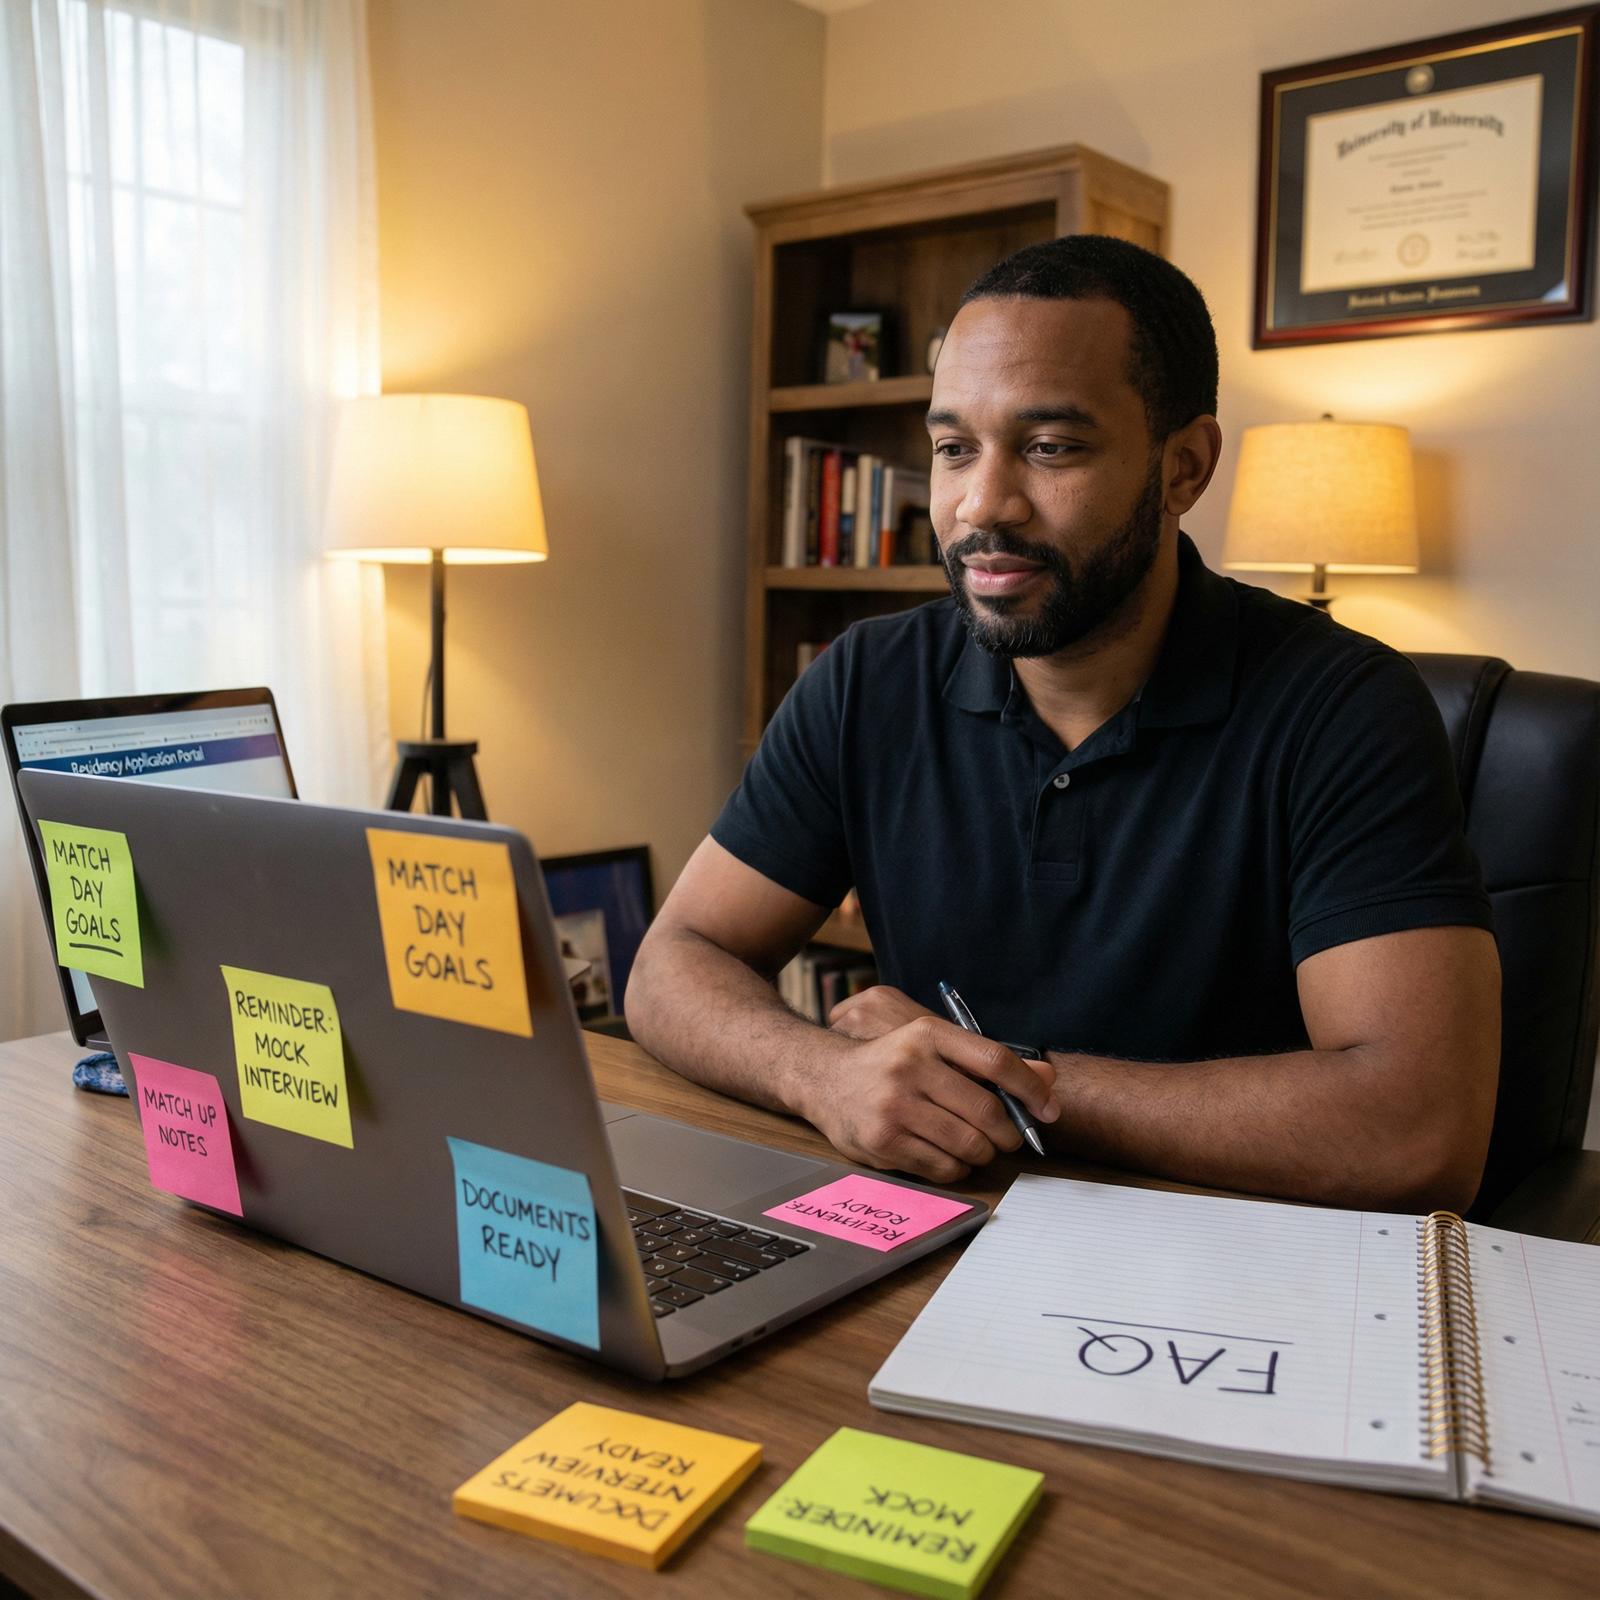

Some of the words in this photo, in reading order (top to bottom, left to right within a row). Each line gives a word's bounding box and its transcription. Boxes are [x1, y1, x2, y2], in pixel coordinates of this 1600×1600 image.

[52, 839, 112, 873] MATCH
[70, 875, 103, 909] DAY
[388, 858, 478, 900] MATCH
[66, 907, 121, 943] GOALS
[414, 904, 465, 948] DAY
[405, 944, 494, 991] GOALS
[235, 990, 334, 1034] REMINDER:
[255, 1031, 310, 1067] MOCK
[144, 1086, 193, 1121] MATCH
[197, 1103, 217, 1127] UP
[244, 1063, 338, 1108] INTERVIEW
[158, 1124, 208, 1157] NOTES
[461, 1178, 590, 1241] DOCUMENTS
[482, 1224, 561, 1283] READY
[1077, 1326, 1279, 1394] FAQ
[521, 1452, 695, 1502] NTERVIEW
[582, 1437, 695, 1476] READY
[864, 1485, 974, 1526] MOCK
